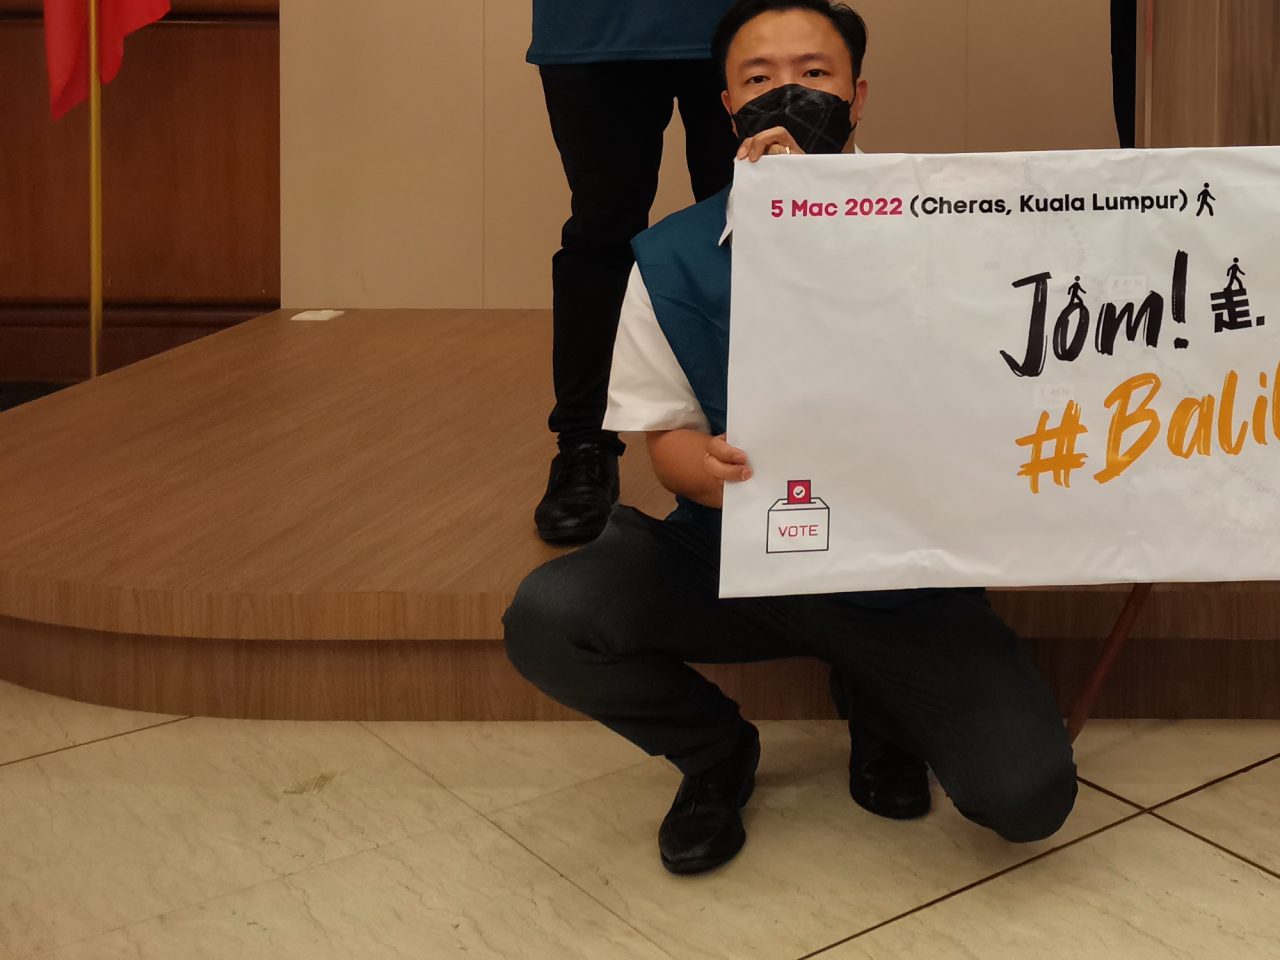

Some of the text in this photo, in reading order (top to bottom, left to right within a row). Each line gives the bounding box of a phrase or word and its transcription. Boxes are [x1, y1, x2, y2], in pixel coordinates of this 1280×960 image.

[771, 189, 1188, 218] 5 Mac 2022 (Cheras, Kuala Lumpur)
[999, 248, 1189, 378] Jom!
[778, 523, 819, 539] VOTE
